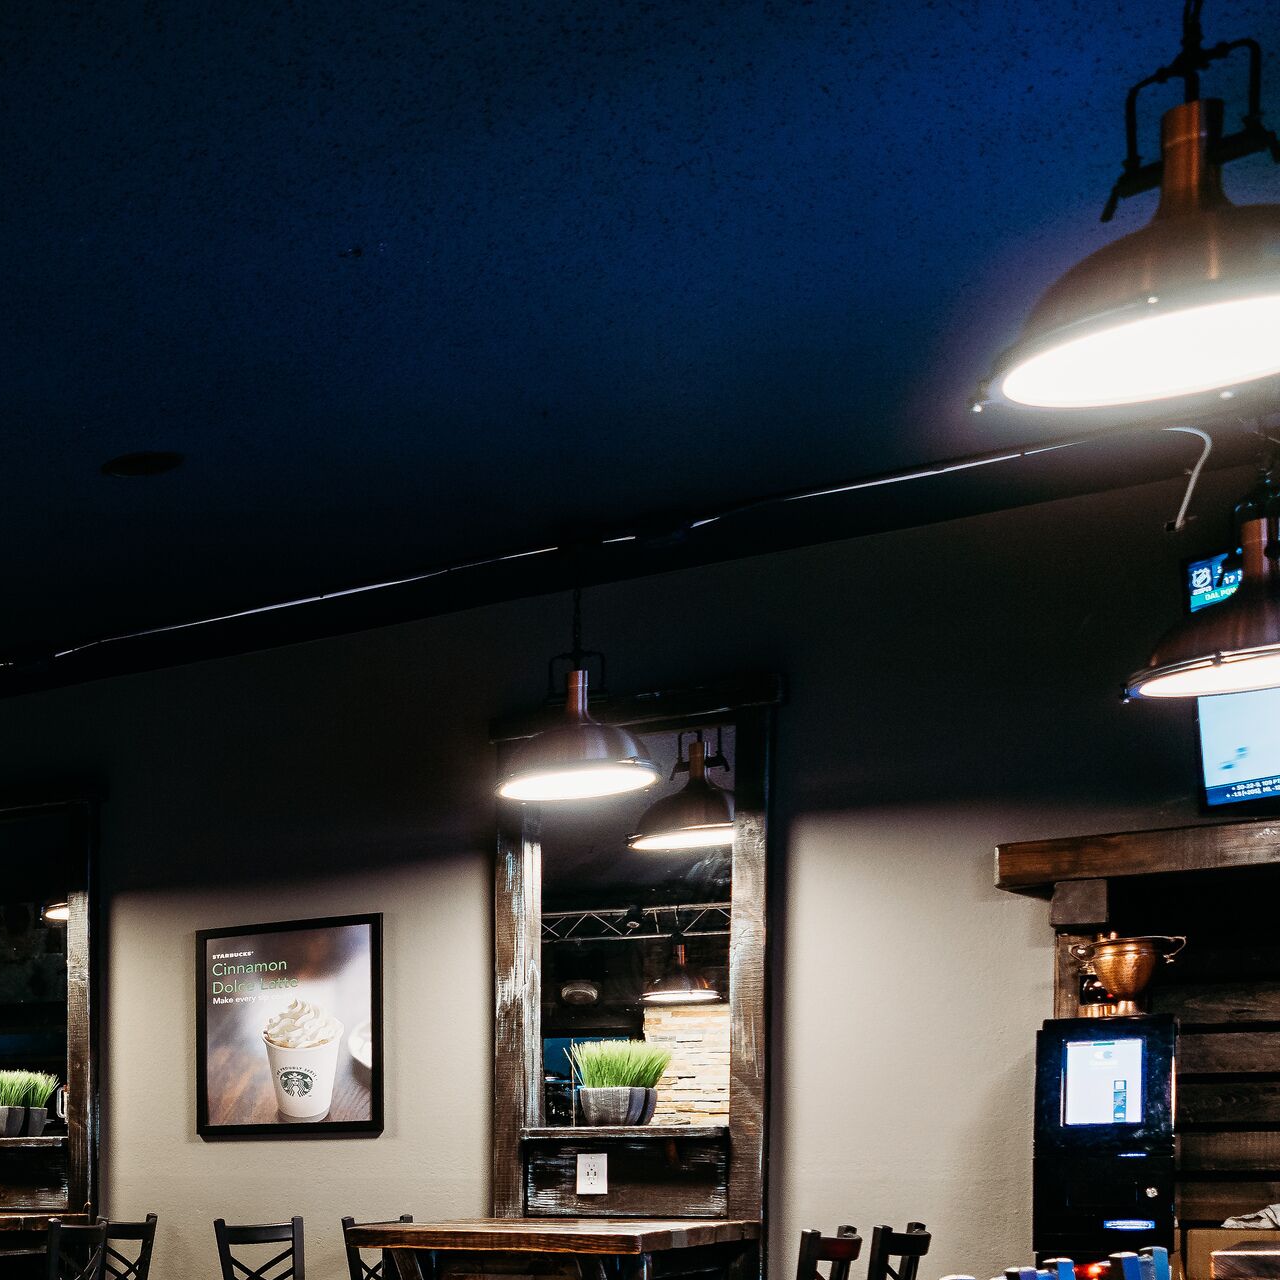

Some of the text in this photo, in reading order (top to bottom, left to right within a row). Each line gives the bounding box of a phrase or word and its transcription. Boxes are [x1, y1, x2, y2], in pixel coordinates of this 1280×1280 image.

[212, 961, 287, 976] Cinnamon
[212, 977, 298, 995] Dolce Latte
[213, 997, 233, 1005] Make
[236, 995, 256, 1004] every
